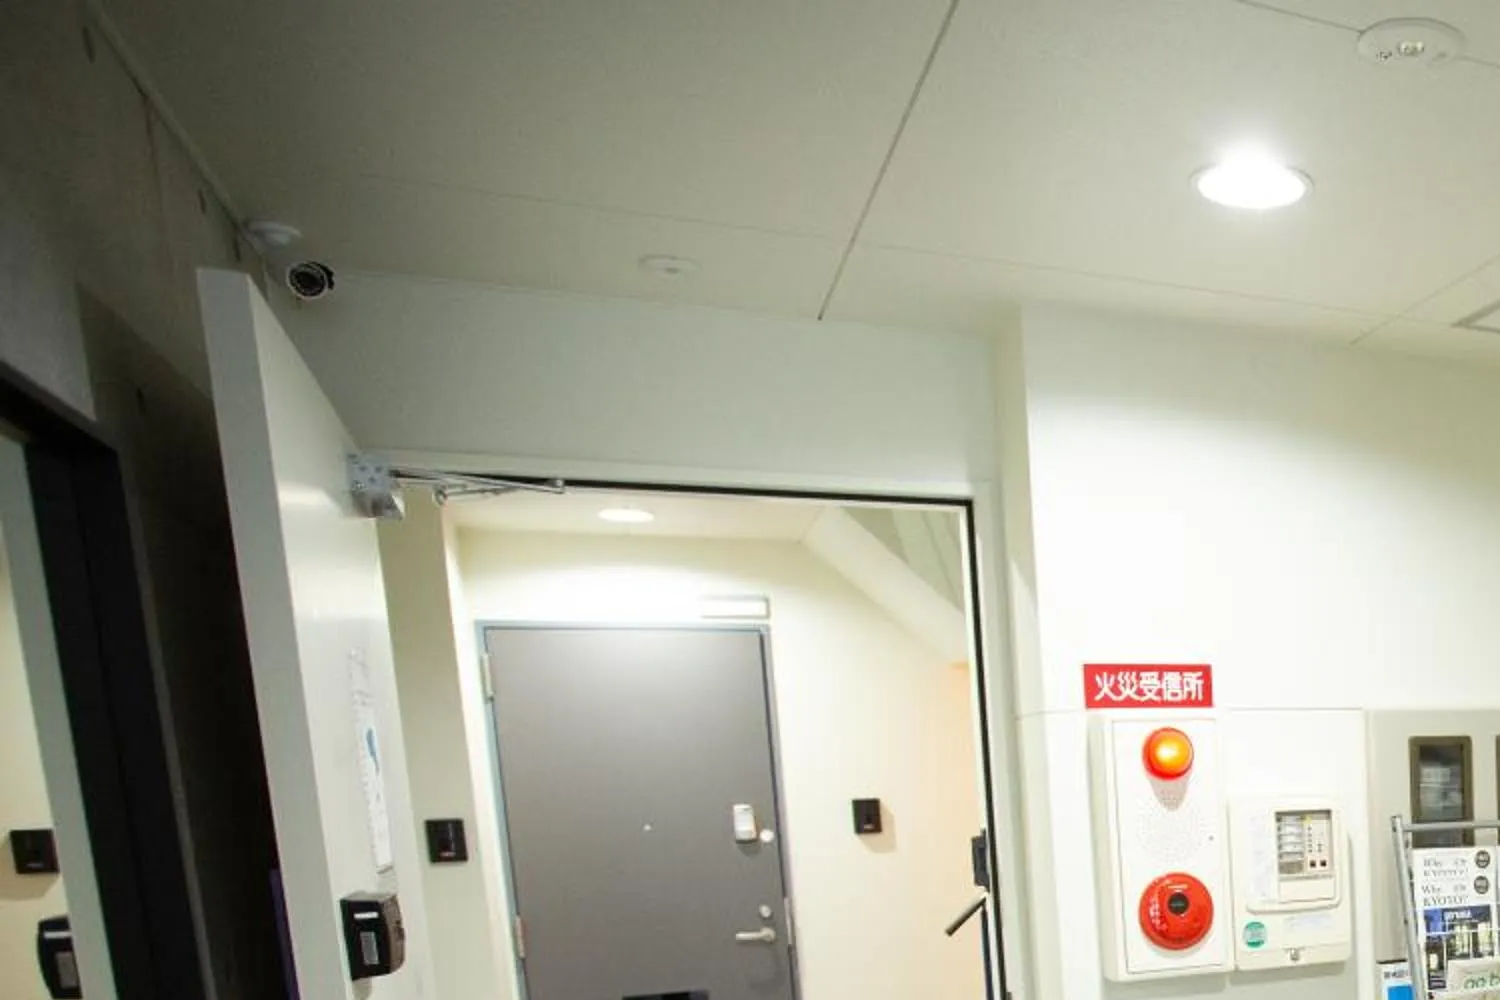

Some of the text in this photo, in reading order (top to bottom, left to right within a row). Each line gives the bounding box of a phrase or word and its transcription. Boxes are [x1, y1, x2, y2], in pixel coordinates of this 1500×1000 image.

[1094, 671, 1204, 702] 火災受信所
